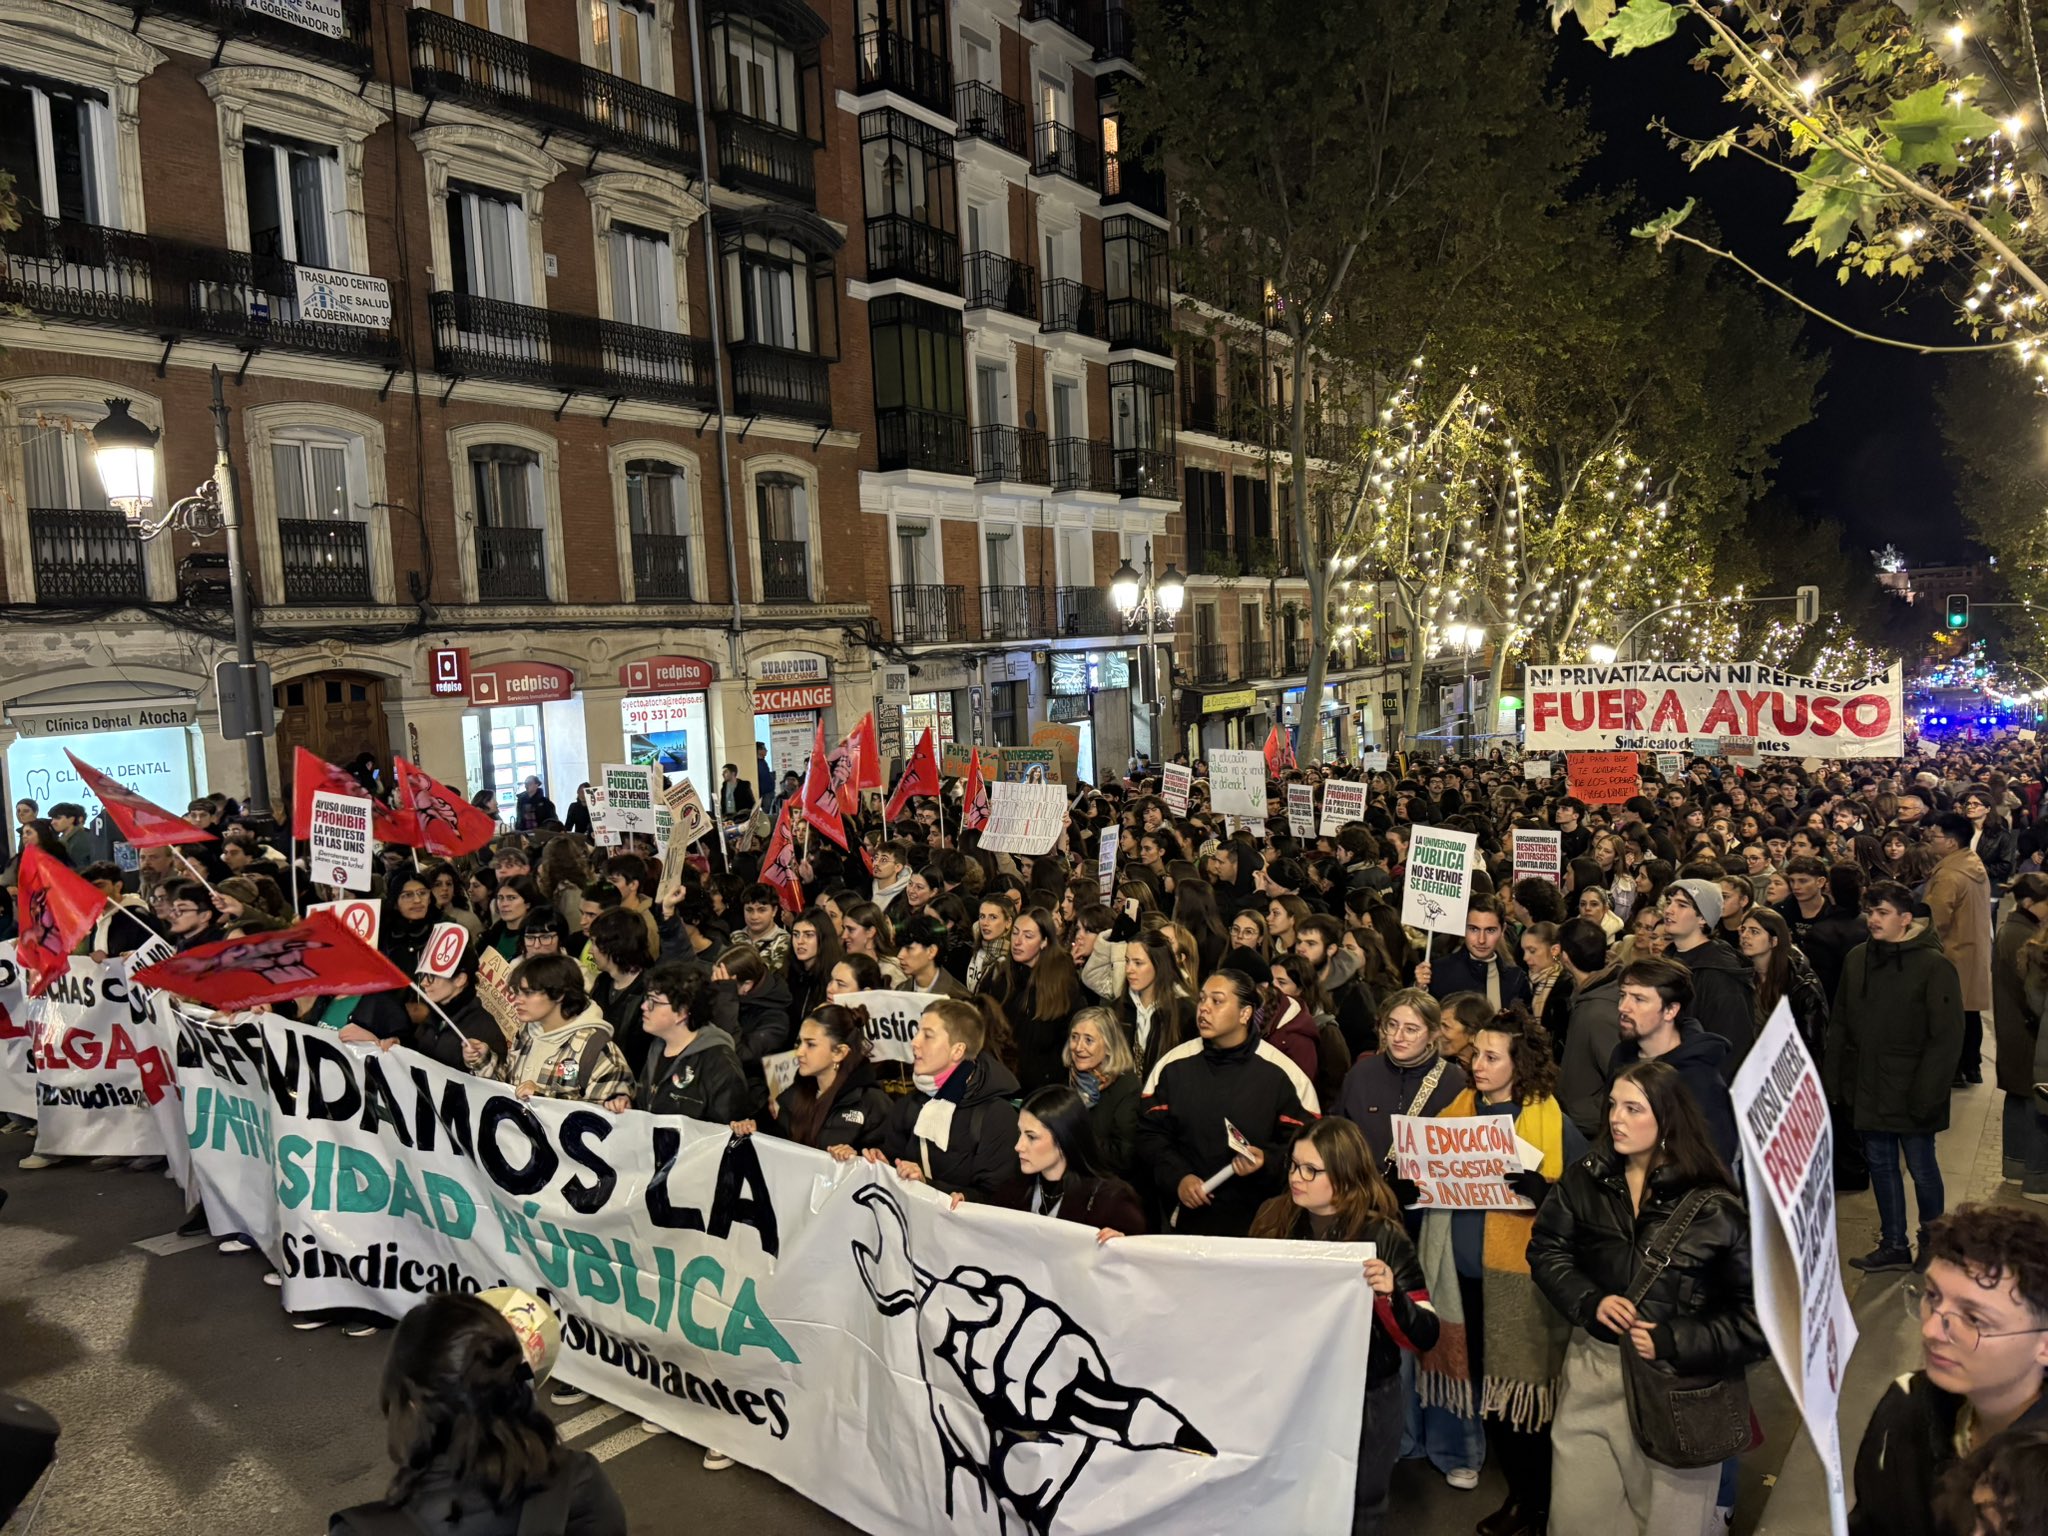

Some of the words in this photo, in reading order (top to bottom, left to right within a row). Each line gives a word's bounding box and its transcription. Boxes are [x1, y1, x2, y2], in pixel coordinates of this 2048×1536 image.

[305, 1, 340, 19] SALUD
[260, 1, 329, 33] GOBERNADOR
[332, 25, 342, 37] 39
[300, 271, 348, 288] TRASLADO
[350, 278, 386, 293] CENTRO
[340, 294, 352, 305] DE
[355, 298, 389, 310] SALUD
[304, 307, 312, 317] A
[314, 308, 379, 326] GOBERNADOR
[656, 664, 700, 680] redpiso
[761, 659, 818, 674] EUROPOUND
[505, 675, 559, 692] redpiso
[787, 671, 819, 680] EXCHANGE
[1530, 669, 1553, 687] NI
[1560, 662, 1720, 686] PRIVATIZACIÓN
[1728, 666, 1751, 683] NI
[1757, 666, 1890, 693] REPRESIÓN
[436, 682, 462, 692] redpiso
[753, 687, 832, 711] EXCHANGE
[1383, 698, 1397, 707] 101
[46, 718, 89, 733] Clínica
[92, 715, 132, 729] Dental
[139, 710, 187, 726] Atocha
[630, 711, 648, 722] 910
[651, 709, 668, 720] 331
[671, 708, 687, 719] 201
[1533, 689, 1689, 734] FUERA
[1700, 690, 1891, 738] AYUSO
[1615, 735, 1678, 749] Sindicato
[1679, 737, 1695, 749] de
[118, 762, 171, 777] DENTAL
[608, 778, 648, 790] PUBLICA
[1587, 777, 1606, 786] LOS
[608, 790, 619, 798] NO
[619, 790, 628, 799] SE
[628, 791, 650, 800] VENDE
[1327, 790, 1363, 802] PROHIBIR
[316, 800, 338, 812] AYUSO
[340, 804, 366, 817] QUIERE
[609, 799, 619, 808] SE
[619, 800, 650, 809] DEFIENDE
[1332, 799, 1361, 809] PROTESTA
[1333, 806, 1344, 815] LAS
[1345, 808, 1360, 816] UNIS
[315, 810, 366, 830] PROHIBIR
[314, 824, 323, 835] LA
[325, 826, 365, 842] PROTESTA
[314, 835, 324, 847] EN
[326, 837, 341, 850] LAS
[343, 840, 365, 854] UNIS
[1415, 835, 1423, 845] LA
[1423, 837, 1467, 852] UNIVERSIDAD
[1516, 843, 1557, 853] RESISTENCIA
[1413, 846, 1464, 871] PUBLICA
[1516, 852, 1557, 862] ANTIFASCISTA
[1516, 860, 1538, 869] CONTRA
[1539, 861, 1557, 870] AYUSO
[1411, 864, 1424, 878] NO
[1424, 866, 1435, 880] SE
[1435, 869, 1463, 885] VENDE
[1410, 877, 1421, 891] SE
[1421, 879, 1461, 899] DEFIENDE
[1747, 1076, 1783, 1150] AYUSO
[1771, 1033, 1806, 1103] QUIERE
[1397, 1121, 1418, 1155] LA
[1424, 1119, 1516, 1155] EDUCACIÓN
[1764, 1071, 1825, 1208] PROHIBIR
[1400, 1158, 1421, 1179] NO
[1428, 1160, 1449, 1178] ES
[645, 1127, 779, 1259] LA
[1414, 1180, 1434, 1204] S
[282, 1232, 481, 1295] Sindicato
